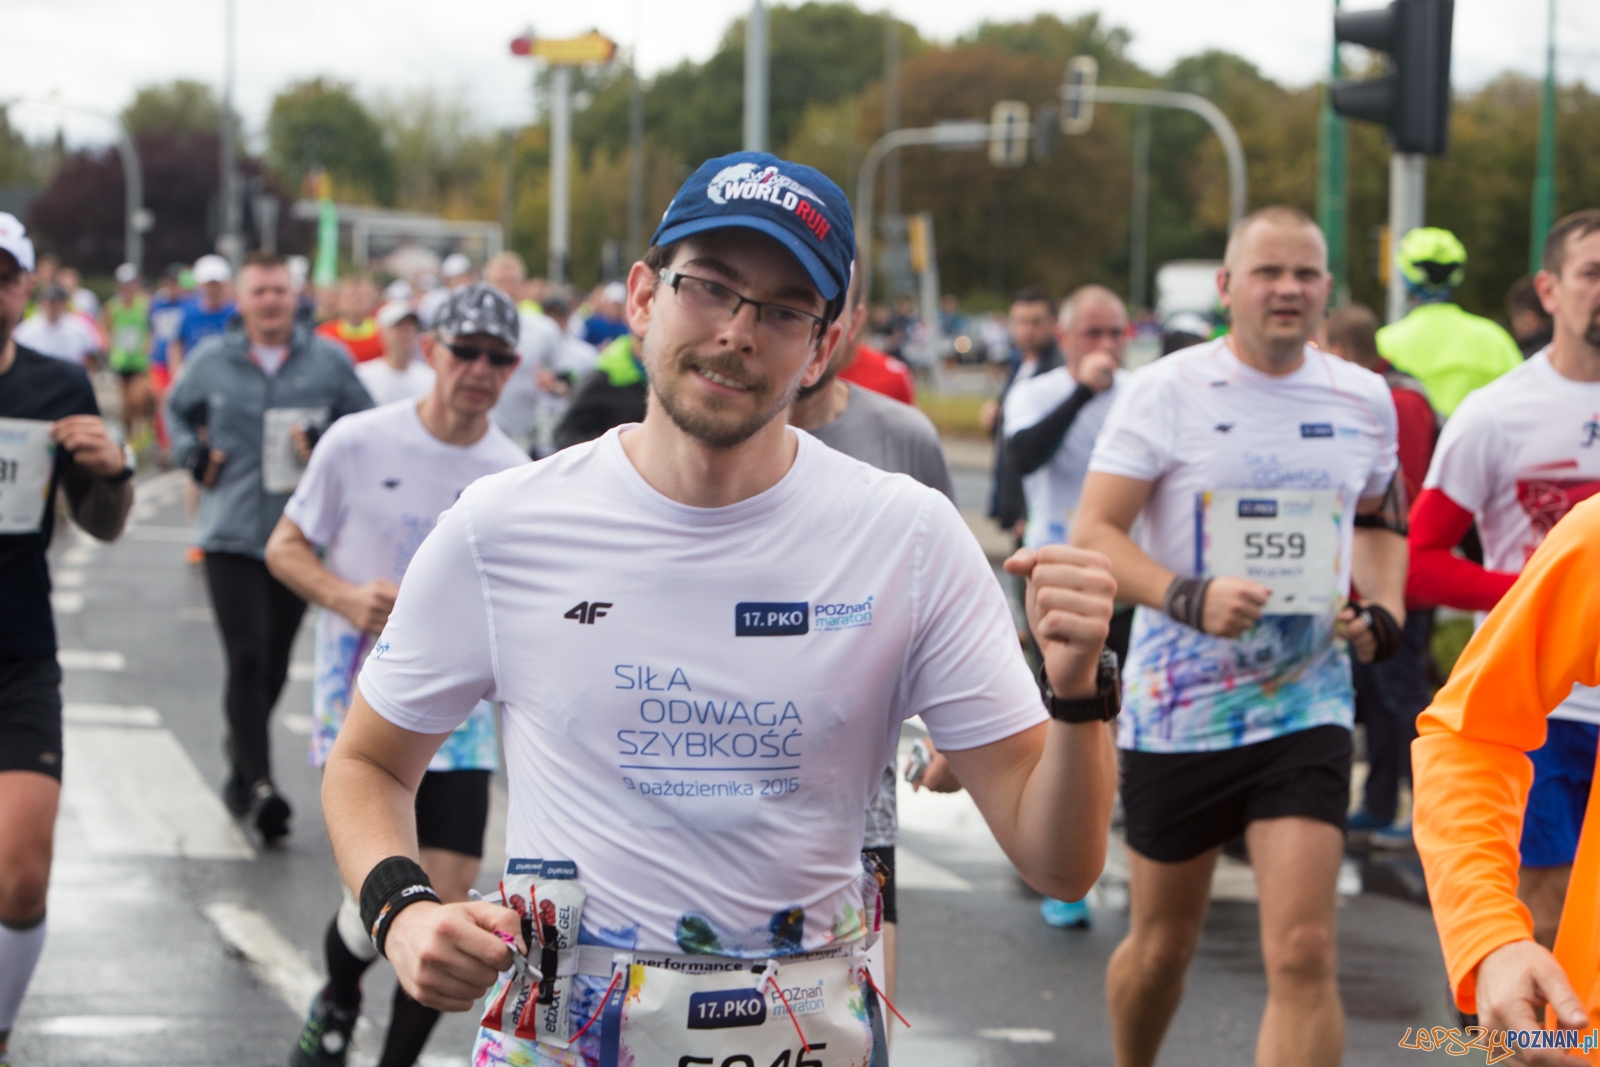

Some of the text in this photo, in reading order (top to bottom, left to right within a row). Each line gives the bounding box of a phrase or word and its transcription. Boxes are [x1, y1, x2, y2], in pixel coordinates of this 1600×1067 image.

[795, 199, 831, 242] RUN
[1244, 532, 1306, 559] 559
[563, 600, 614, 625] 4F
[742, 610, 804, 627] 17. PKO
[815, 611, 873, 628] maraton
[614, 664, 692, 692] SIŁA
[640, 698, 803, 727] ODWAGA
[617, 728, 803, 758] SZYBKOŚĆ
[622, 776, 636, 790] 9
[759, 776, 800, 796] 2016
[546, 867, 575, 875] DURING
[558, 905, 570, 930] GEL
[697, 1002, 721, 1019] 17.
[723, 998, 762, 1018] PKO
